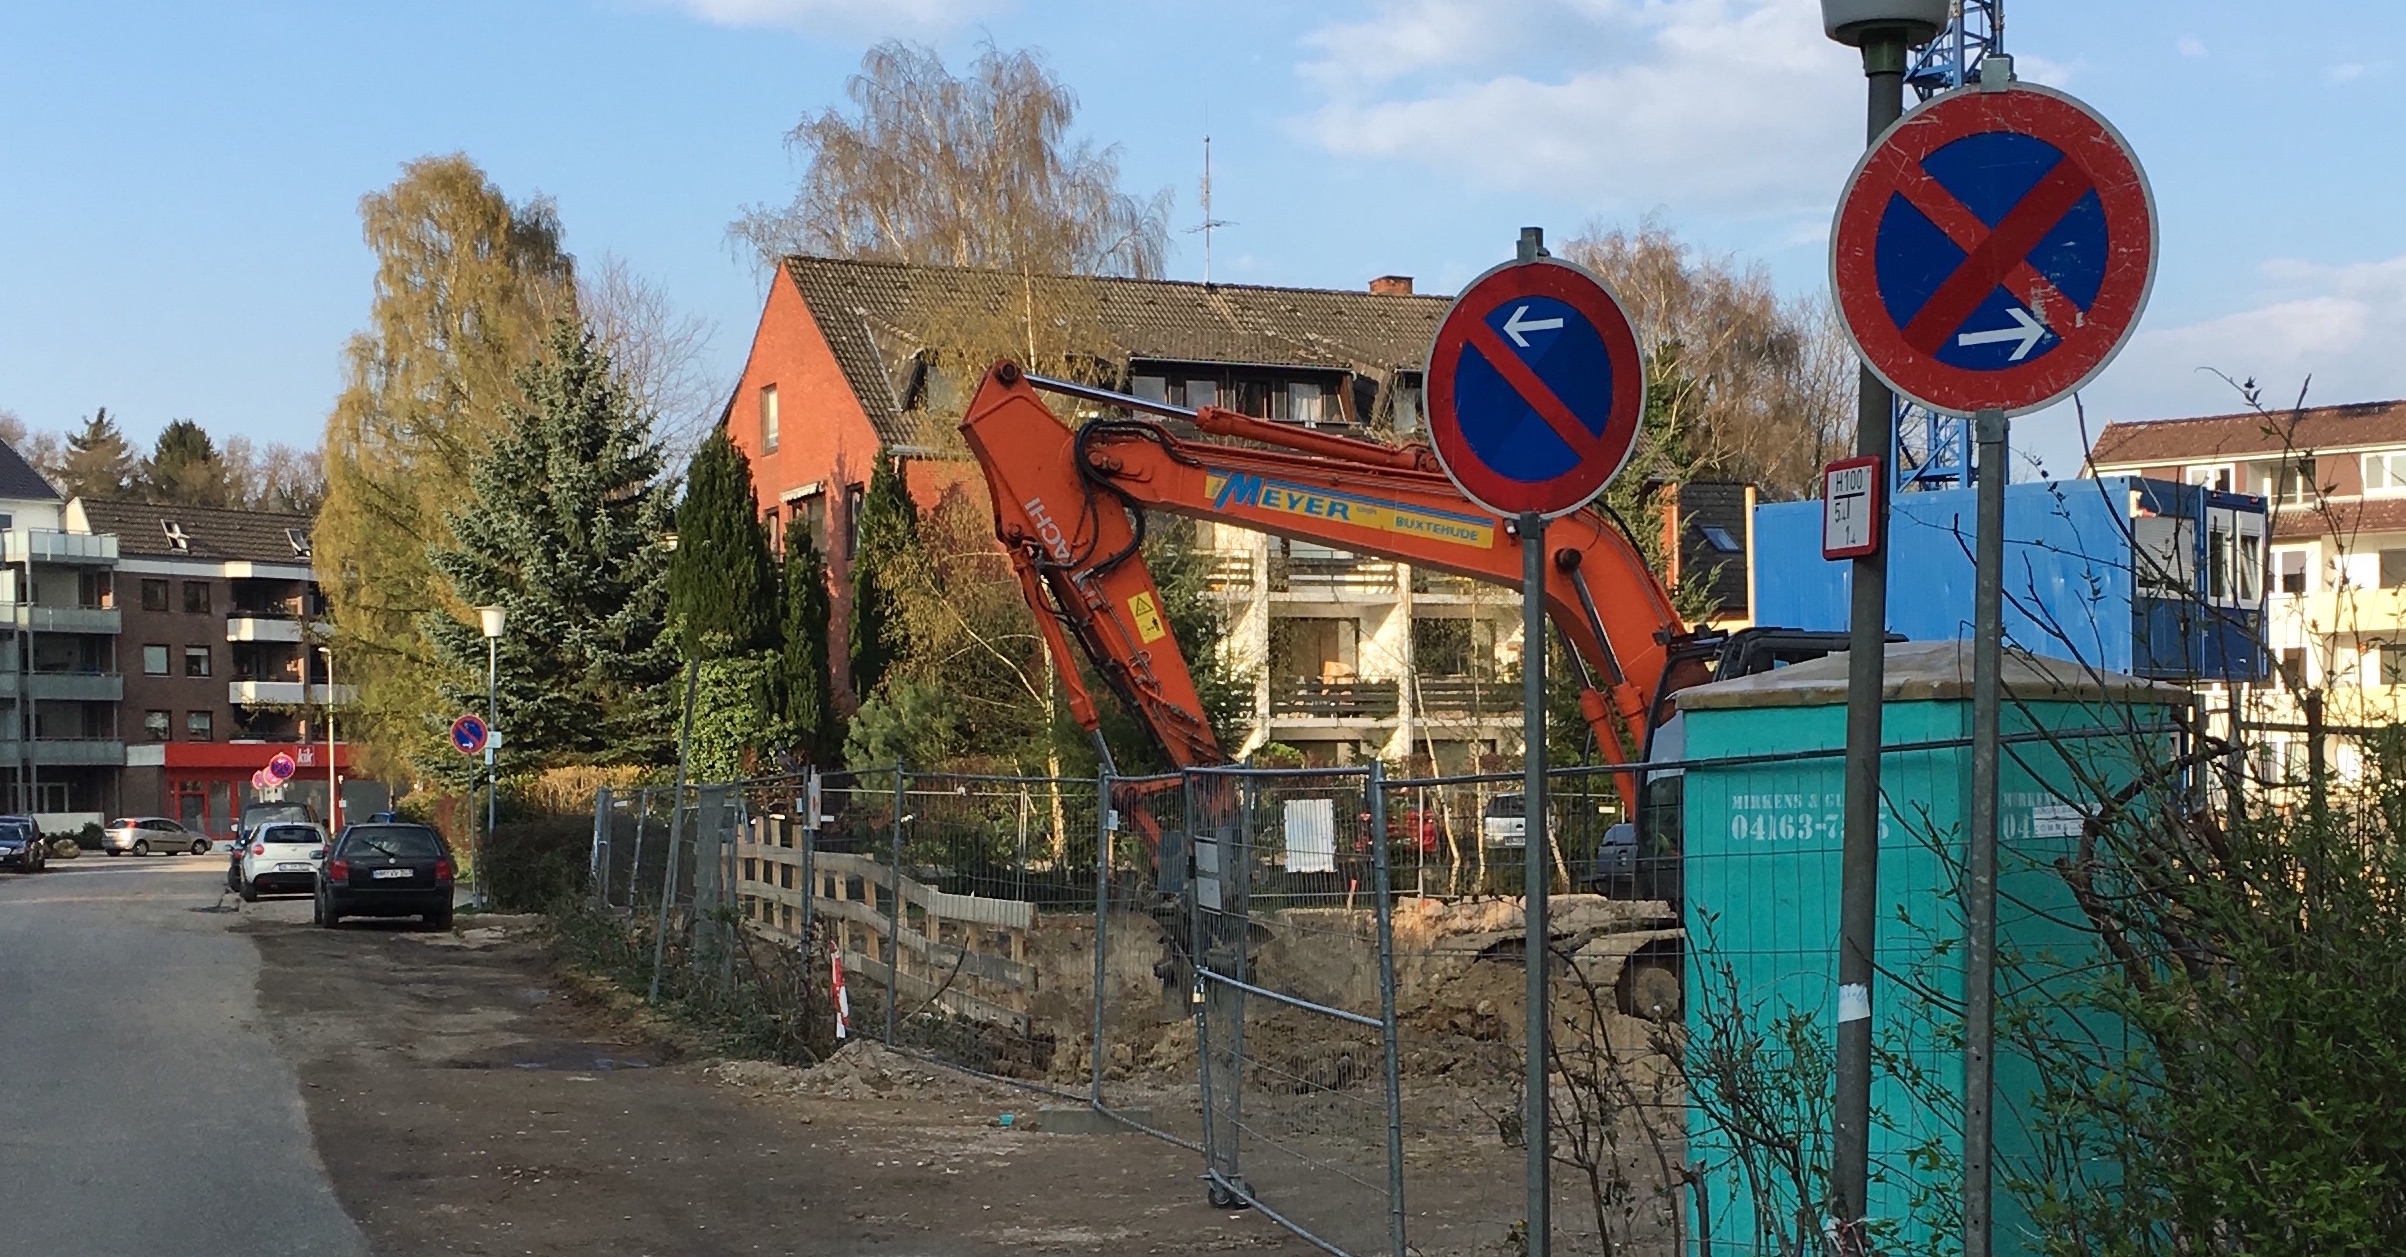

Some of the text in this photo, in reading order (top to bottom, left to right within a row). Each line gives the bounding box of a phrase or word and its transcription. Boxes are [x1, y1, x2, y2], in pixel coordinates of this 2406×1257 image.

[1835, 468, 1863, 492] H100
[1214, 471, 1351, 521] MEYER
[1395, 515, 1479, 542] BUXTEHUDE
[1808, 794, 1818, 808] &
